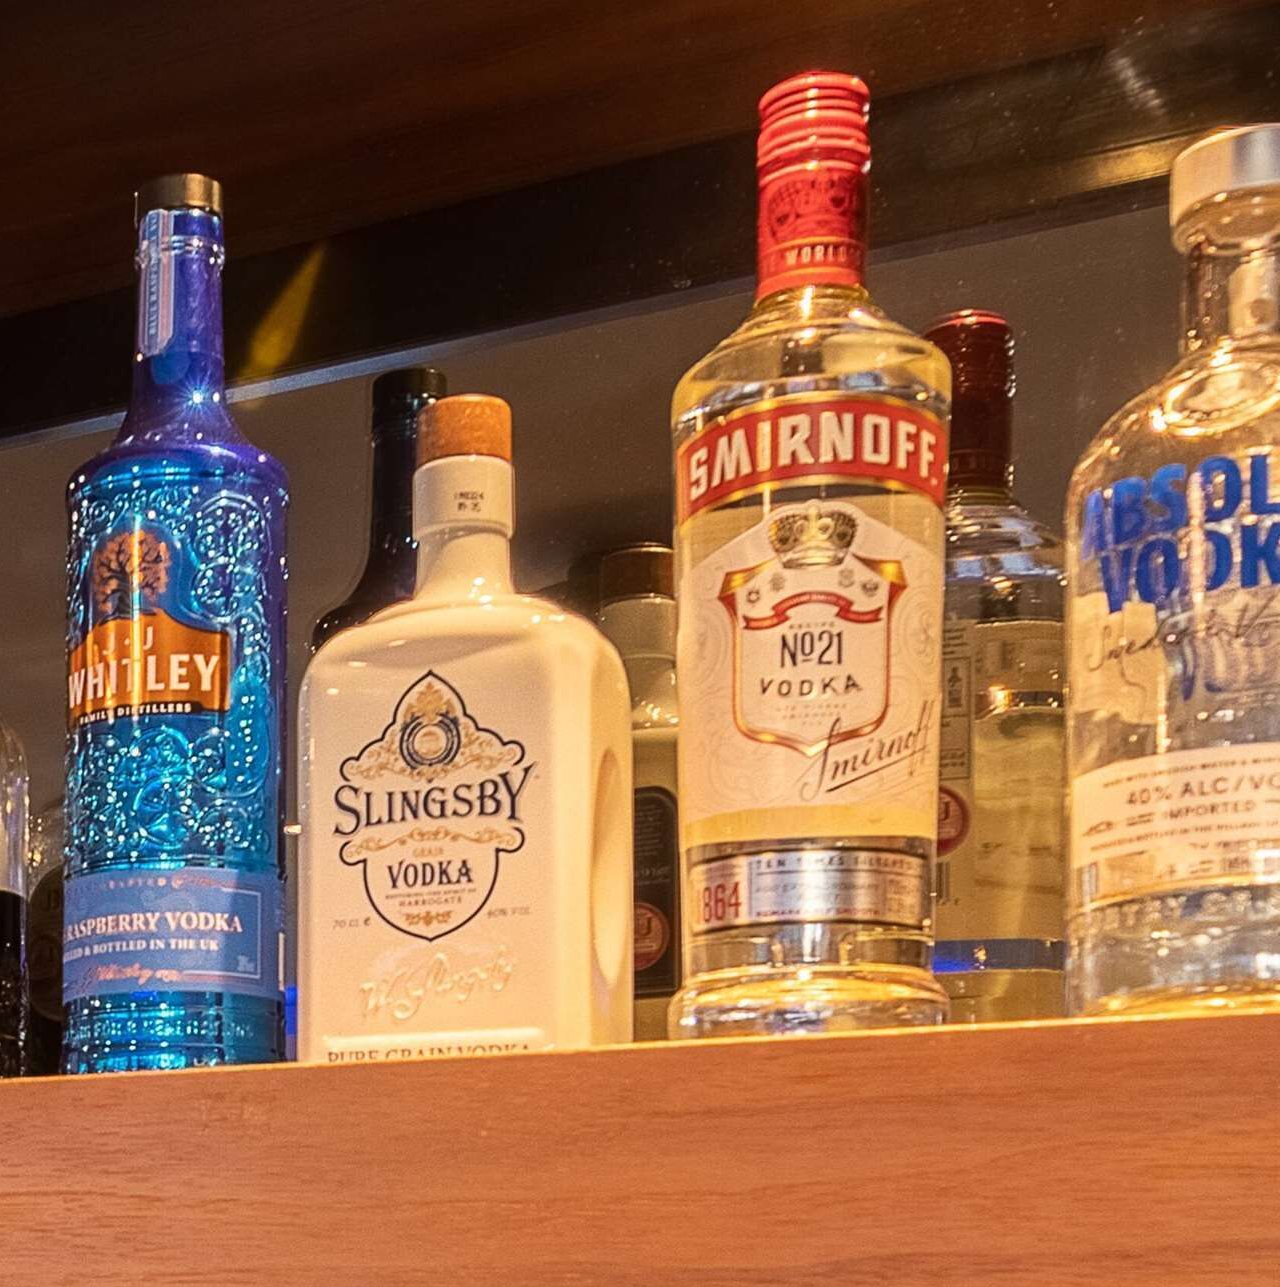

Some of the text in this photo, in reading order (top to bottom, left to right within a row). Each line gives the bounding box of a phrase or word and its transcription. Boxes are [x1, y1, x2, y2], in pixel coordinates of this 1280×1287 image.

[785, 244, 848, 266] WORLD
[690, 410, 936, 501] SMIRNOFF
[1080, 452, 1280, 562] ABSOL
[68, 653, 221, 710] WHITLEY
[759, 673, 864, 698] VODKA
[79, 702, 192, 726] FAMILY DISTILLERS
[332, 761, 539, 837] SLINGSBY
[386, 858, 474, 890] VODKA
[164, 911, 243, 933] VODKA
[93, 938, 148, 955] BOTTLED
[149, 939, 165, 951] IN
[170, 938, 199, 951] THE
[200, 939, 221, 951] UK
